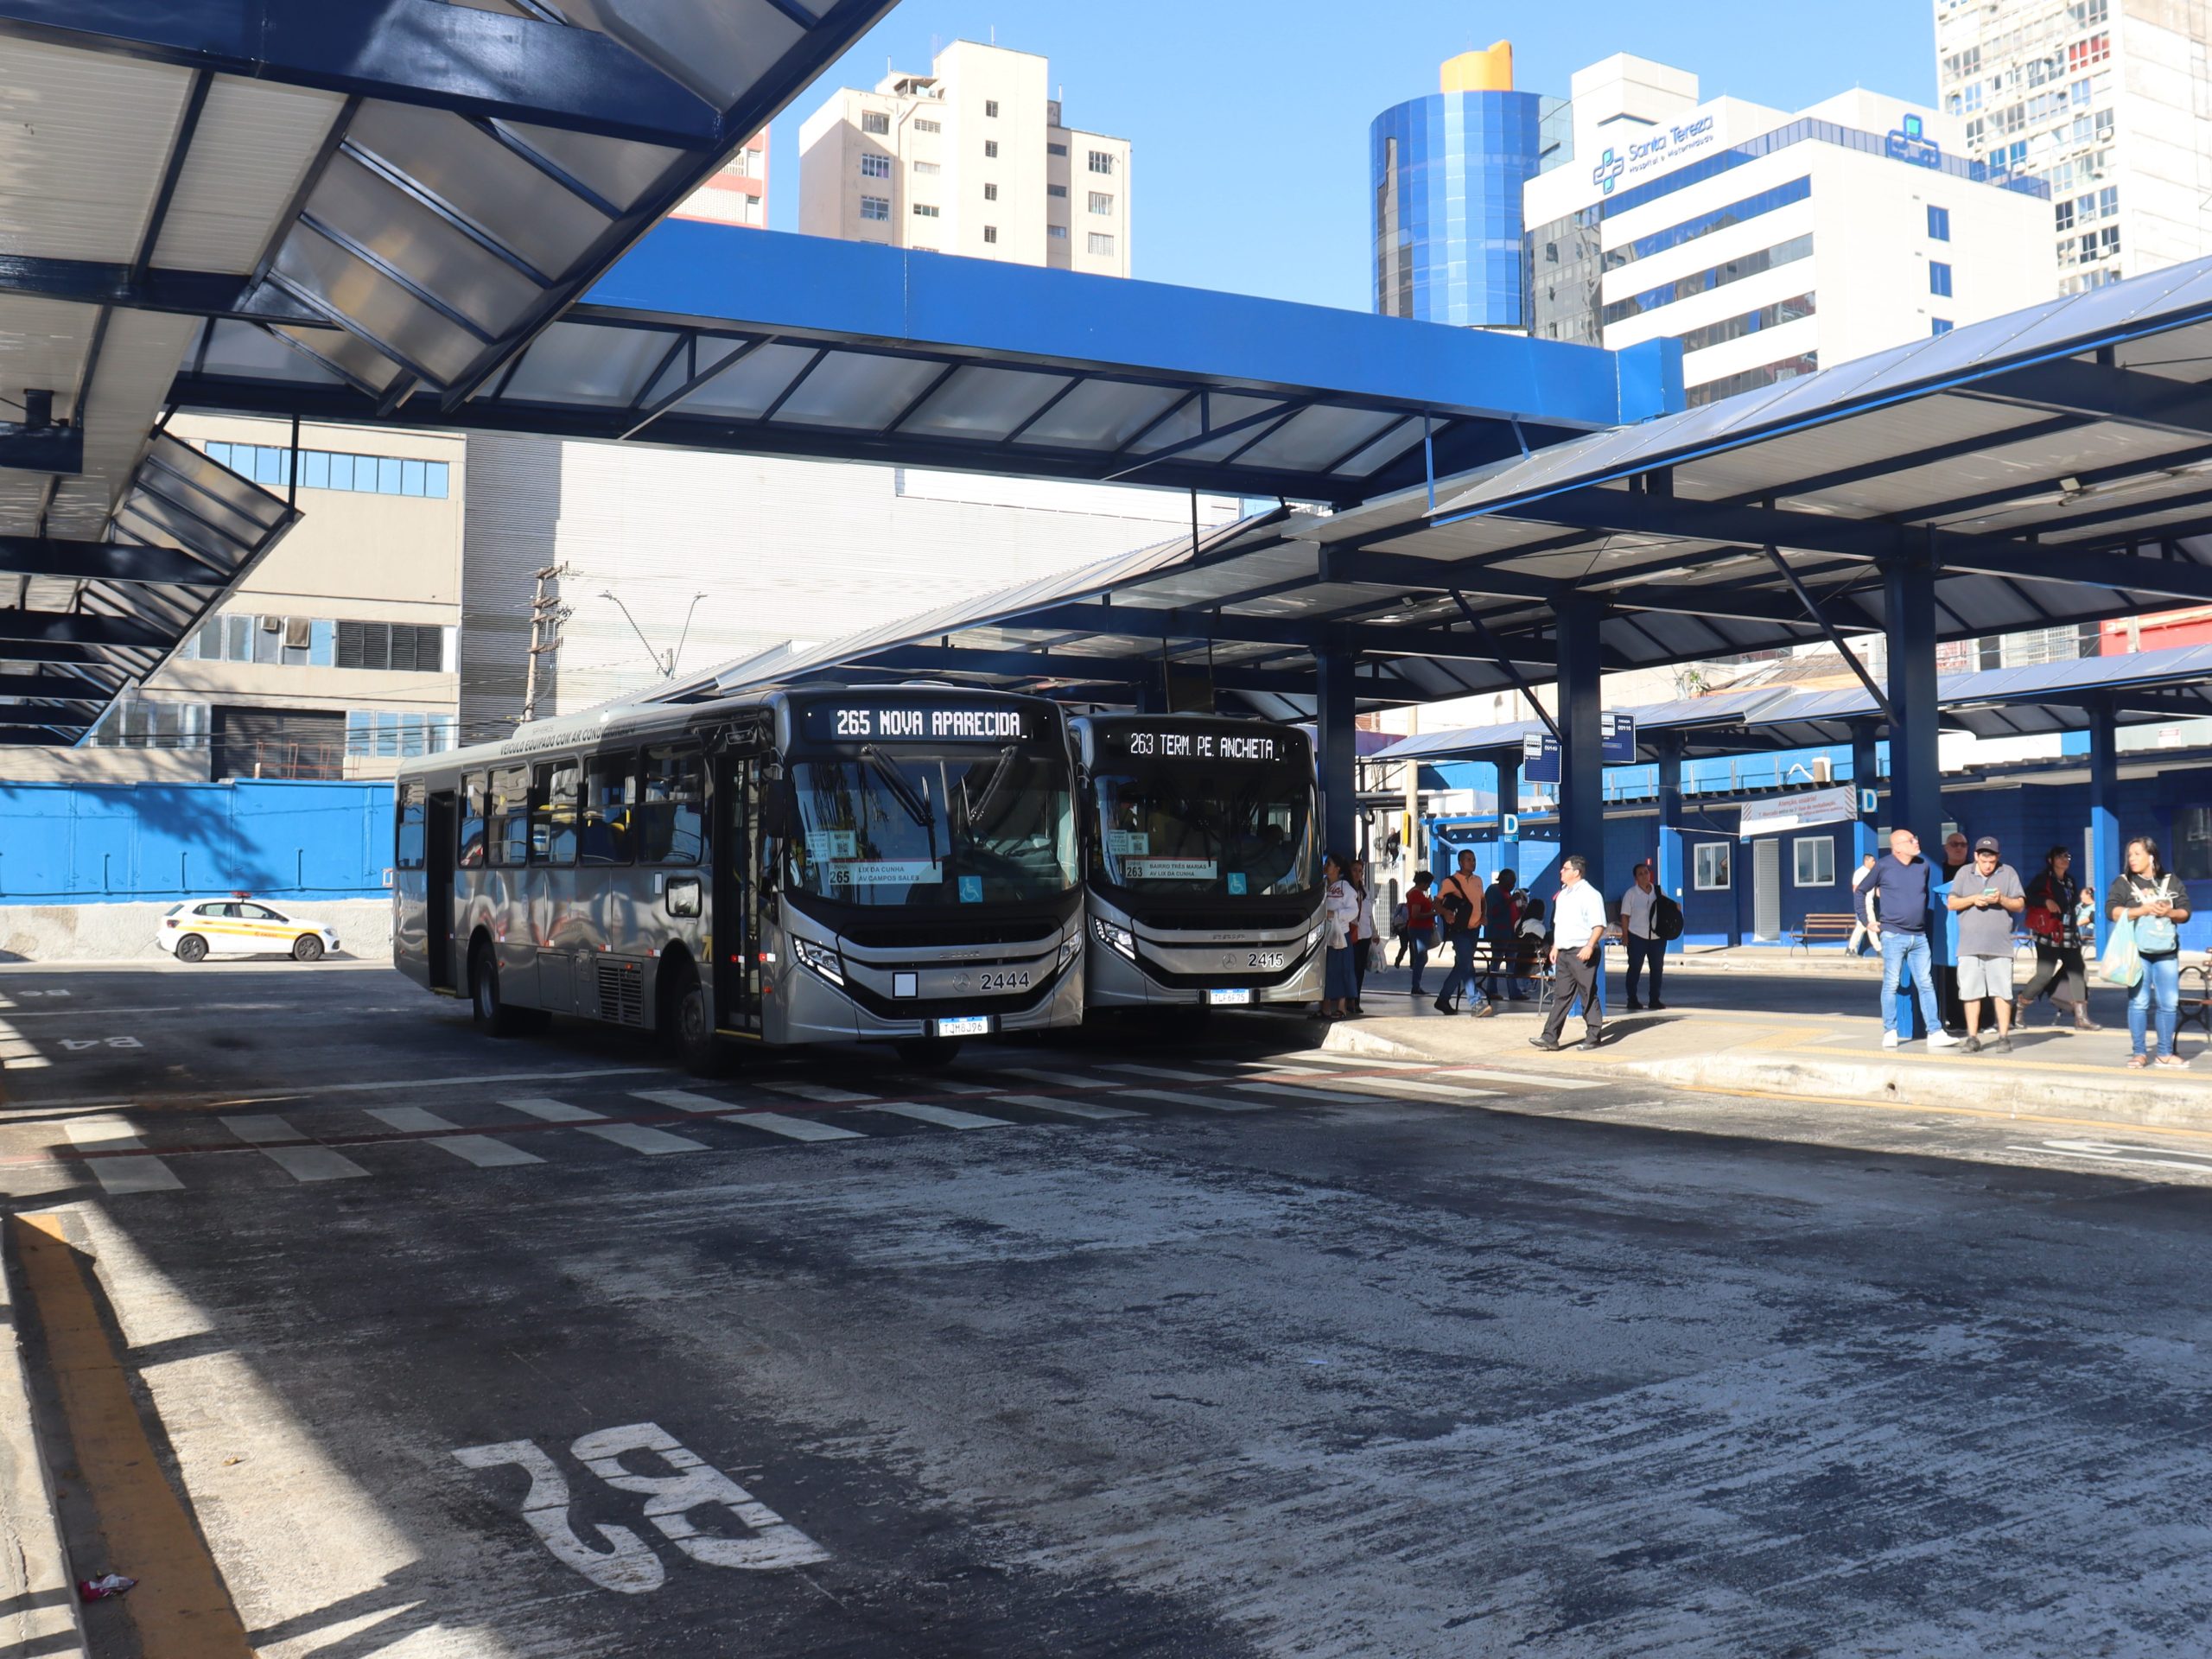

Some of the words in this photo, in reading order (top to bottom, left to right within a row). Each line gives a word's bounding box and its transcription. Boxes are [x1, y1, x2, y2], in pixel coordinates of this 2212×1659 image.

[1629, 136, 1667, 162] Santa
[1669, 115, 1713, 144] Tereza
[1630, 156, 1659, 173] Hospital
[1668, 135, 1713, 157] Maternidade
[837, 709, 870, 734] 265
[880, 710, 923, 735] NOVA
[931, 711, 1020, 736] APARECIDA
[524, 737, 555, 752] EQUIPADO
[556, 733, 570, 747] COM
[571, 731, 582, 743] AR
[1130, 733, 1154, 754] 263
[1160, 734, 1192, 756] TERM.
[1197, 735, 1215, 757] PE.
[1220, 737, 1273, 760] ANCHIETA
[1863, 789, 1878, 813] D
[1504, 814, 1518, 834] D
[830, 870, 850, 883] 265
[1127, 867, 1143, 877] 263
[1248, 953, 1284, 967] 2415
[980, 971, 1030, 991] 2444
[57, 1036, 144, 1051] B4
[450, 1421, 832, 1594] B2
